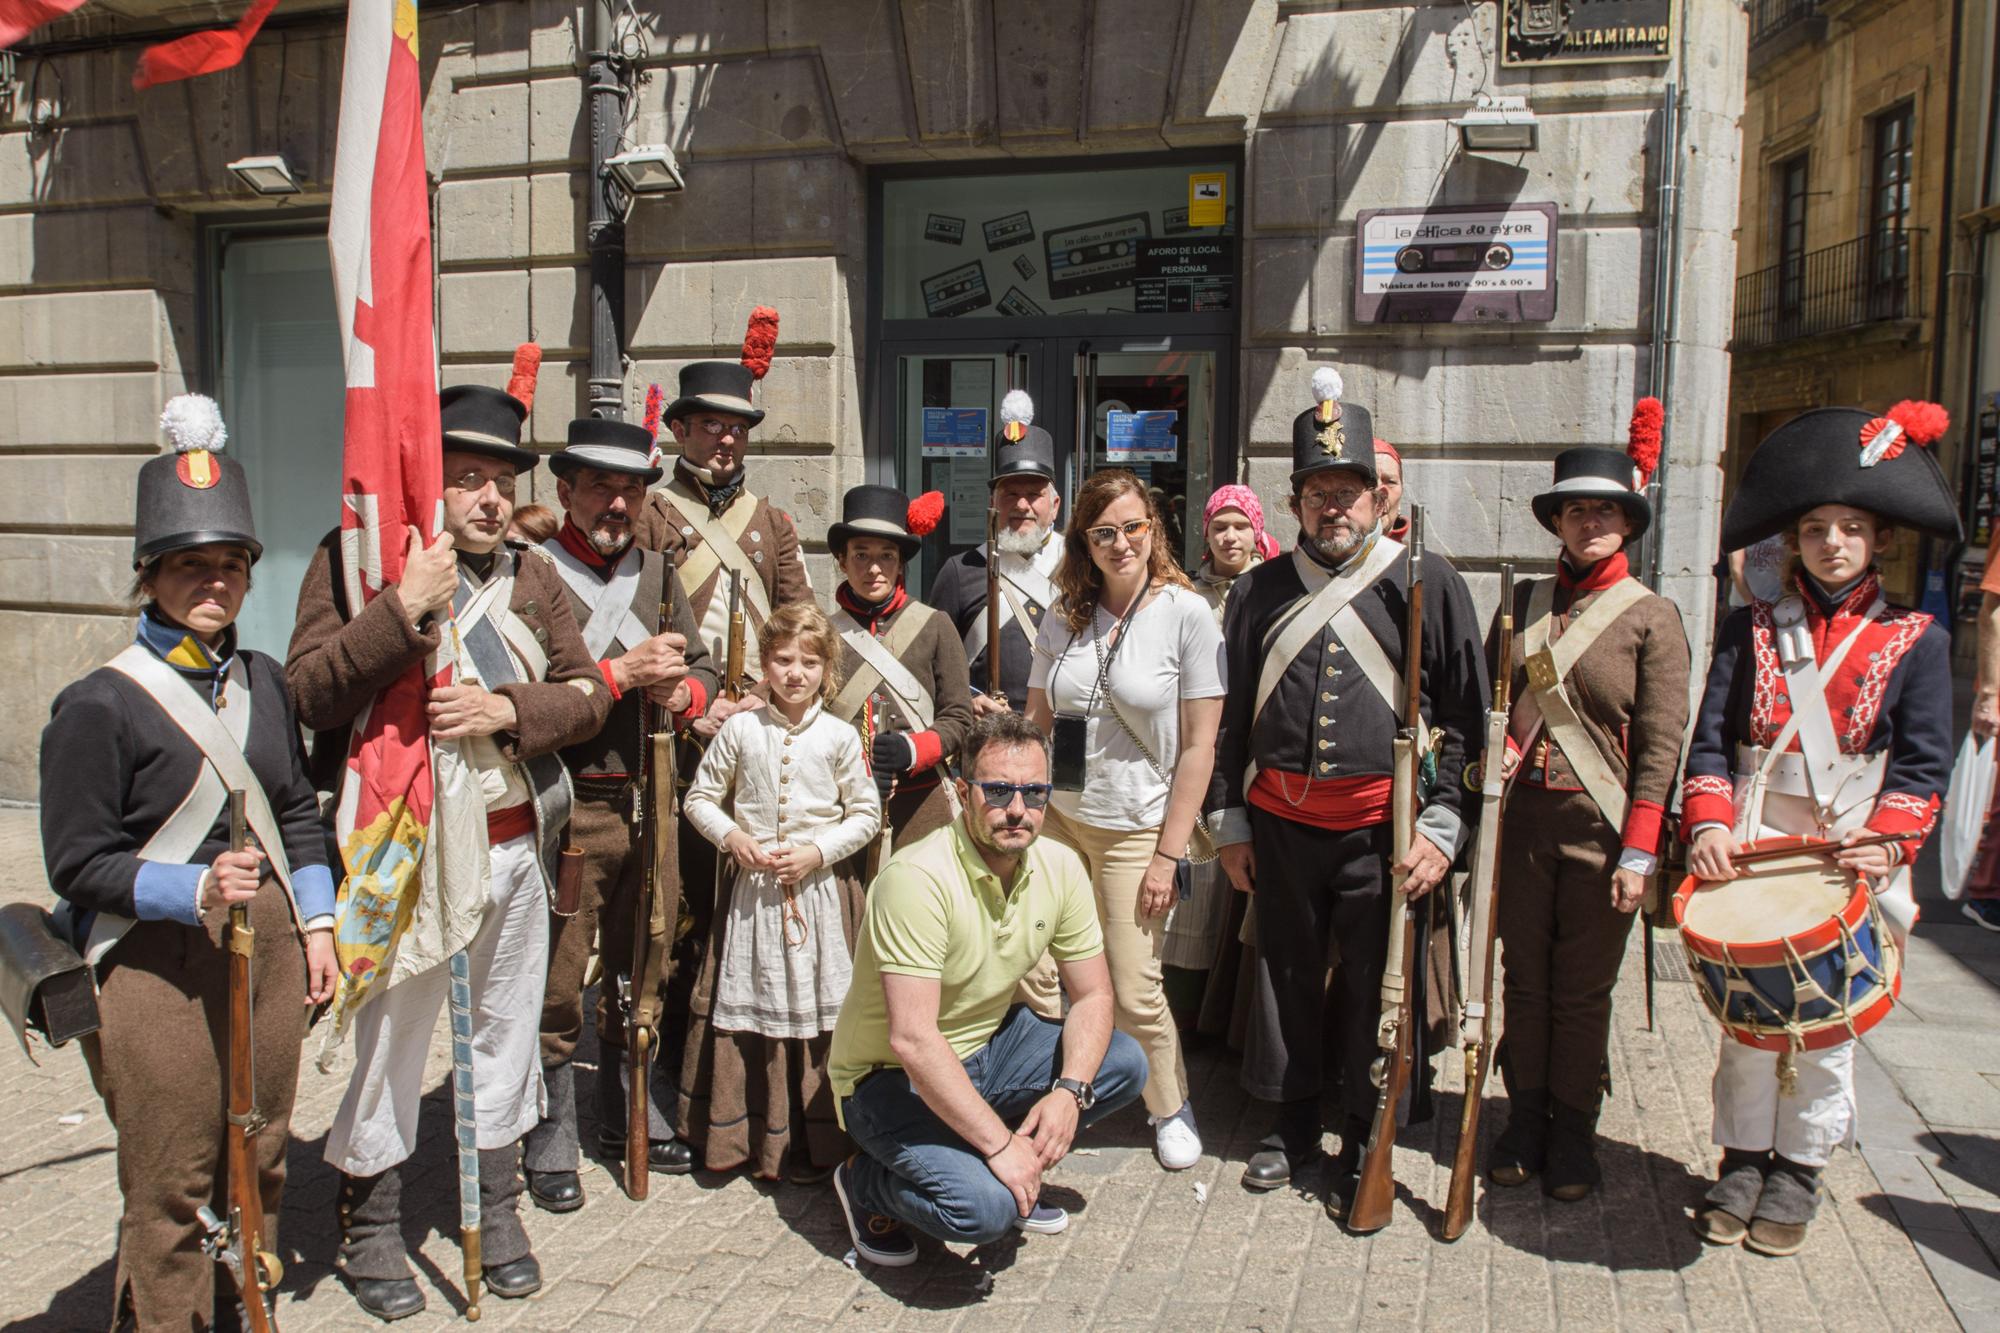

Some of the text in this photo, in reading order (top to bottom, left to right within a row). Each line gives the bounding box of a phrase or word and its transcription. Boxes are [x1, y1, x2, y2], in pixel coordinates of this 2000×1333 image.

[1565, 25, 1668, 46] ALTAMIRANO
[1147, 245, 1222, 257] AFORO DE LOCAL
[1160, 265, 1208, 274] PERSONAS
